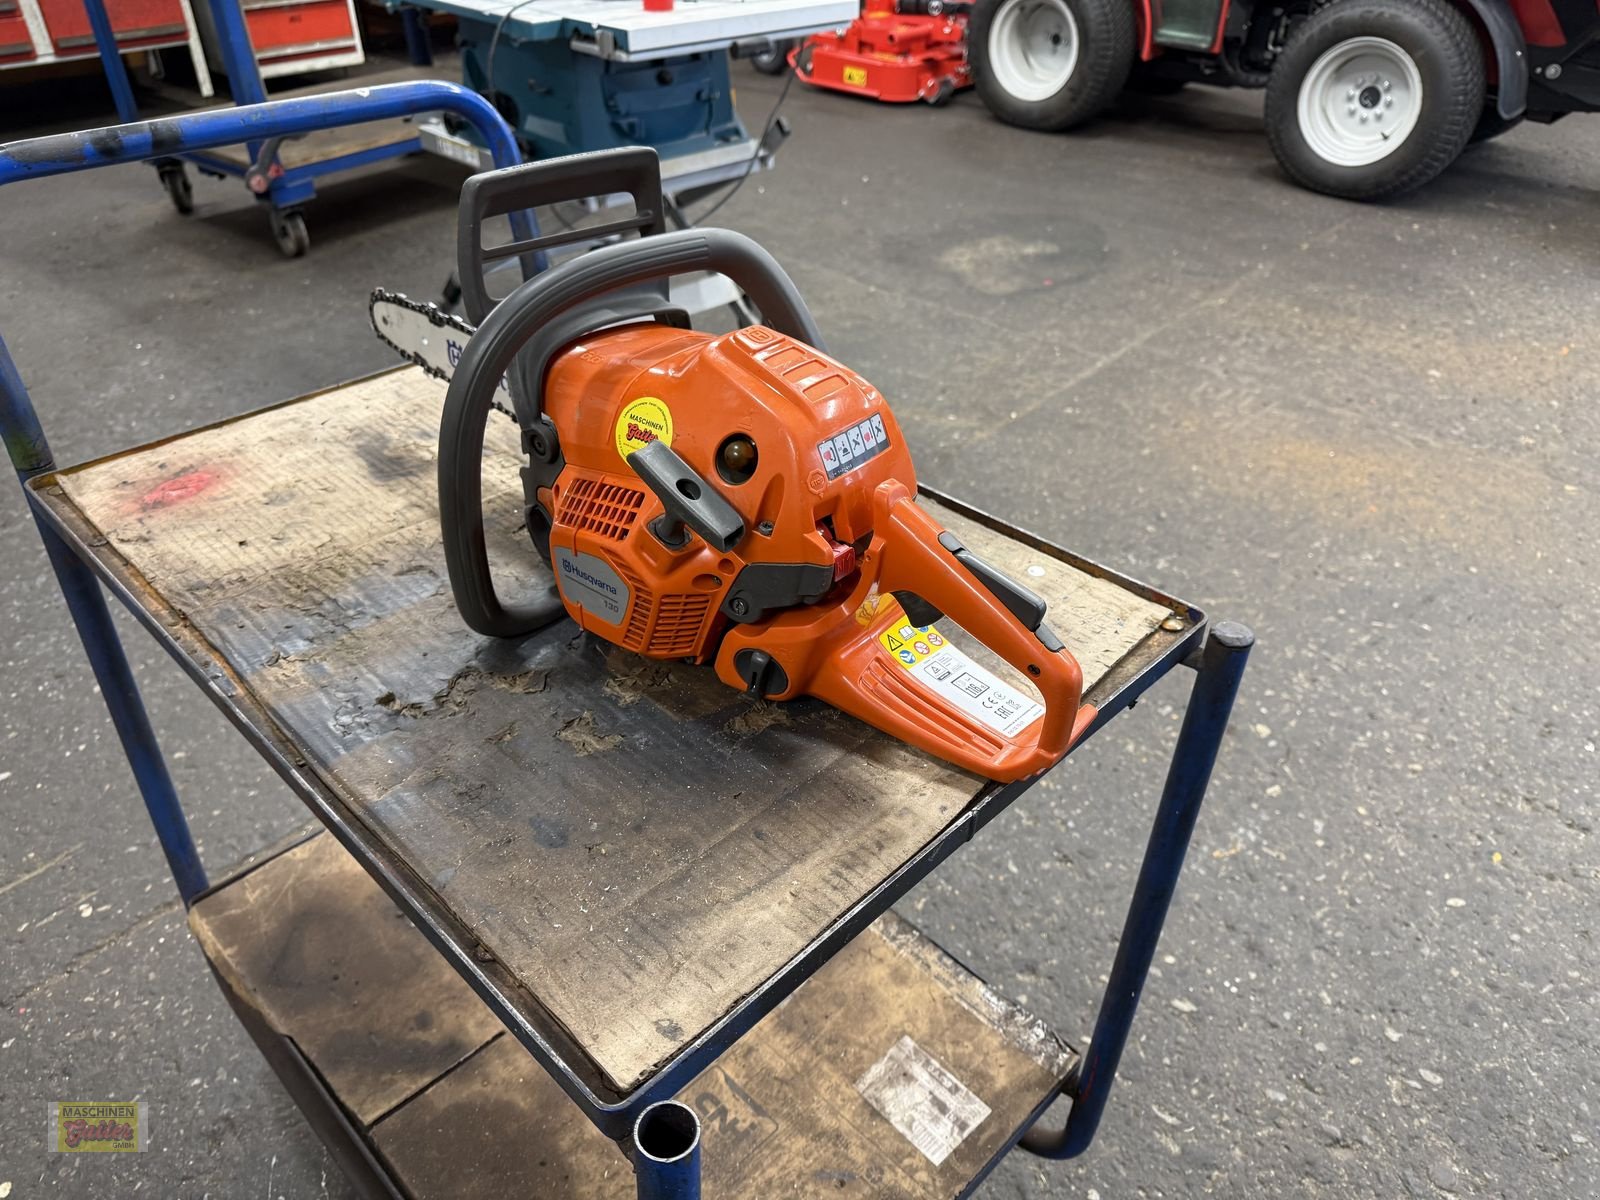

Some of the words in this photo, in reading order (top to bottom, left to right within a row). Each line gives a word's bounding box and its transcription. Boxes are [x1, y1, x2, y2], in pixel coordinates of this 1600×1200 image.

[630, 414, 663, 431] MASCHINEN
[572, 565, 617, 594] Husqvarna
[603, 600, 619, 613] 130
